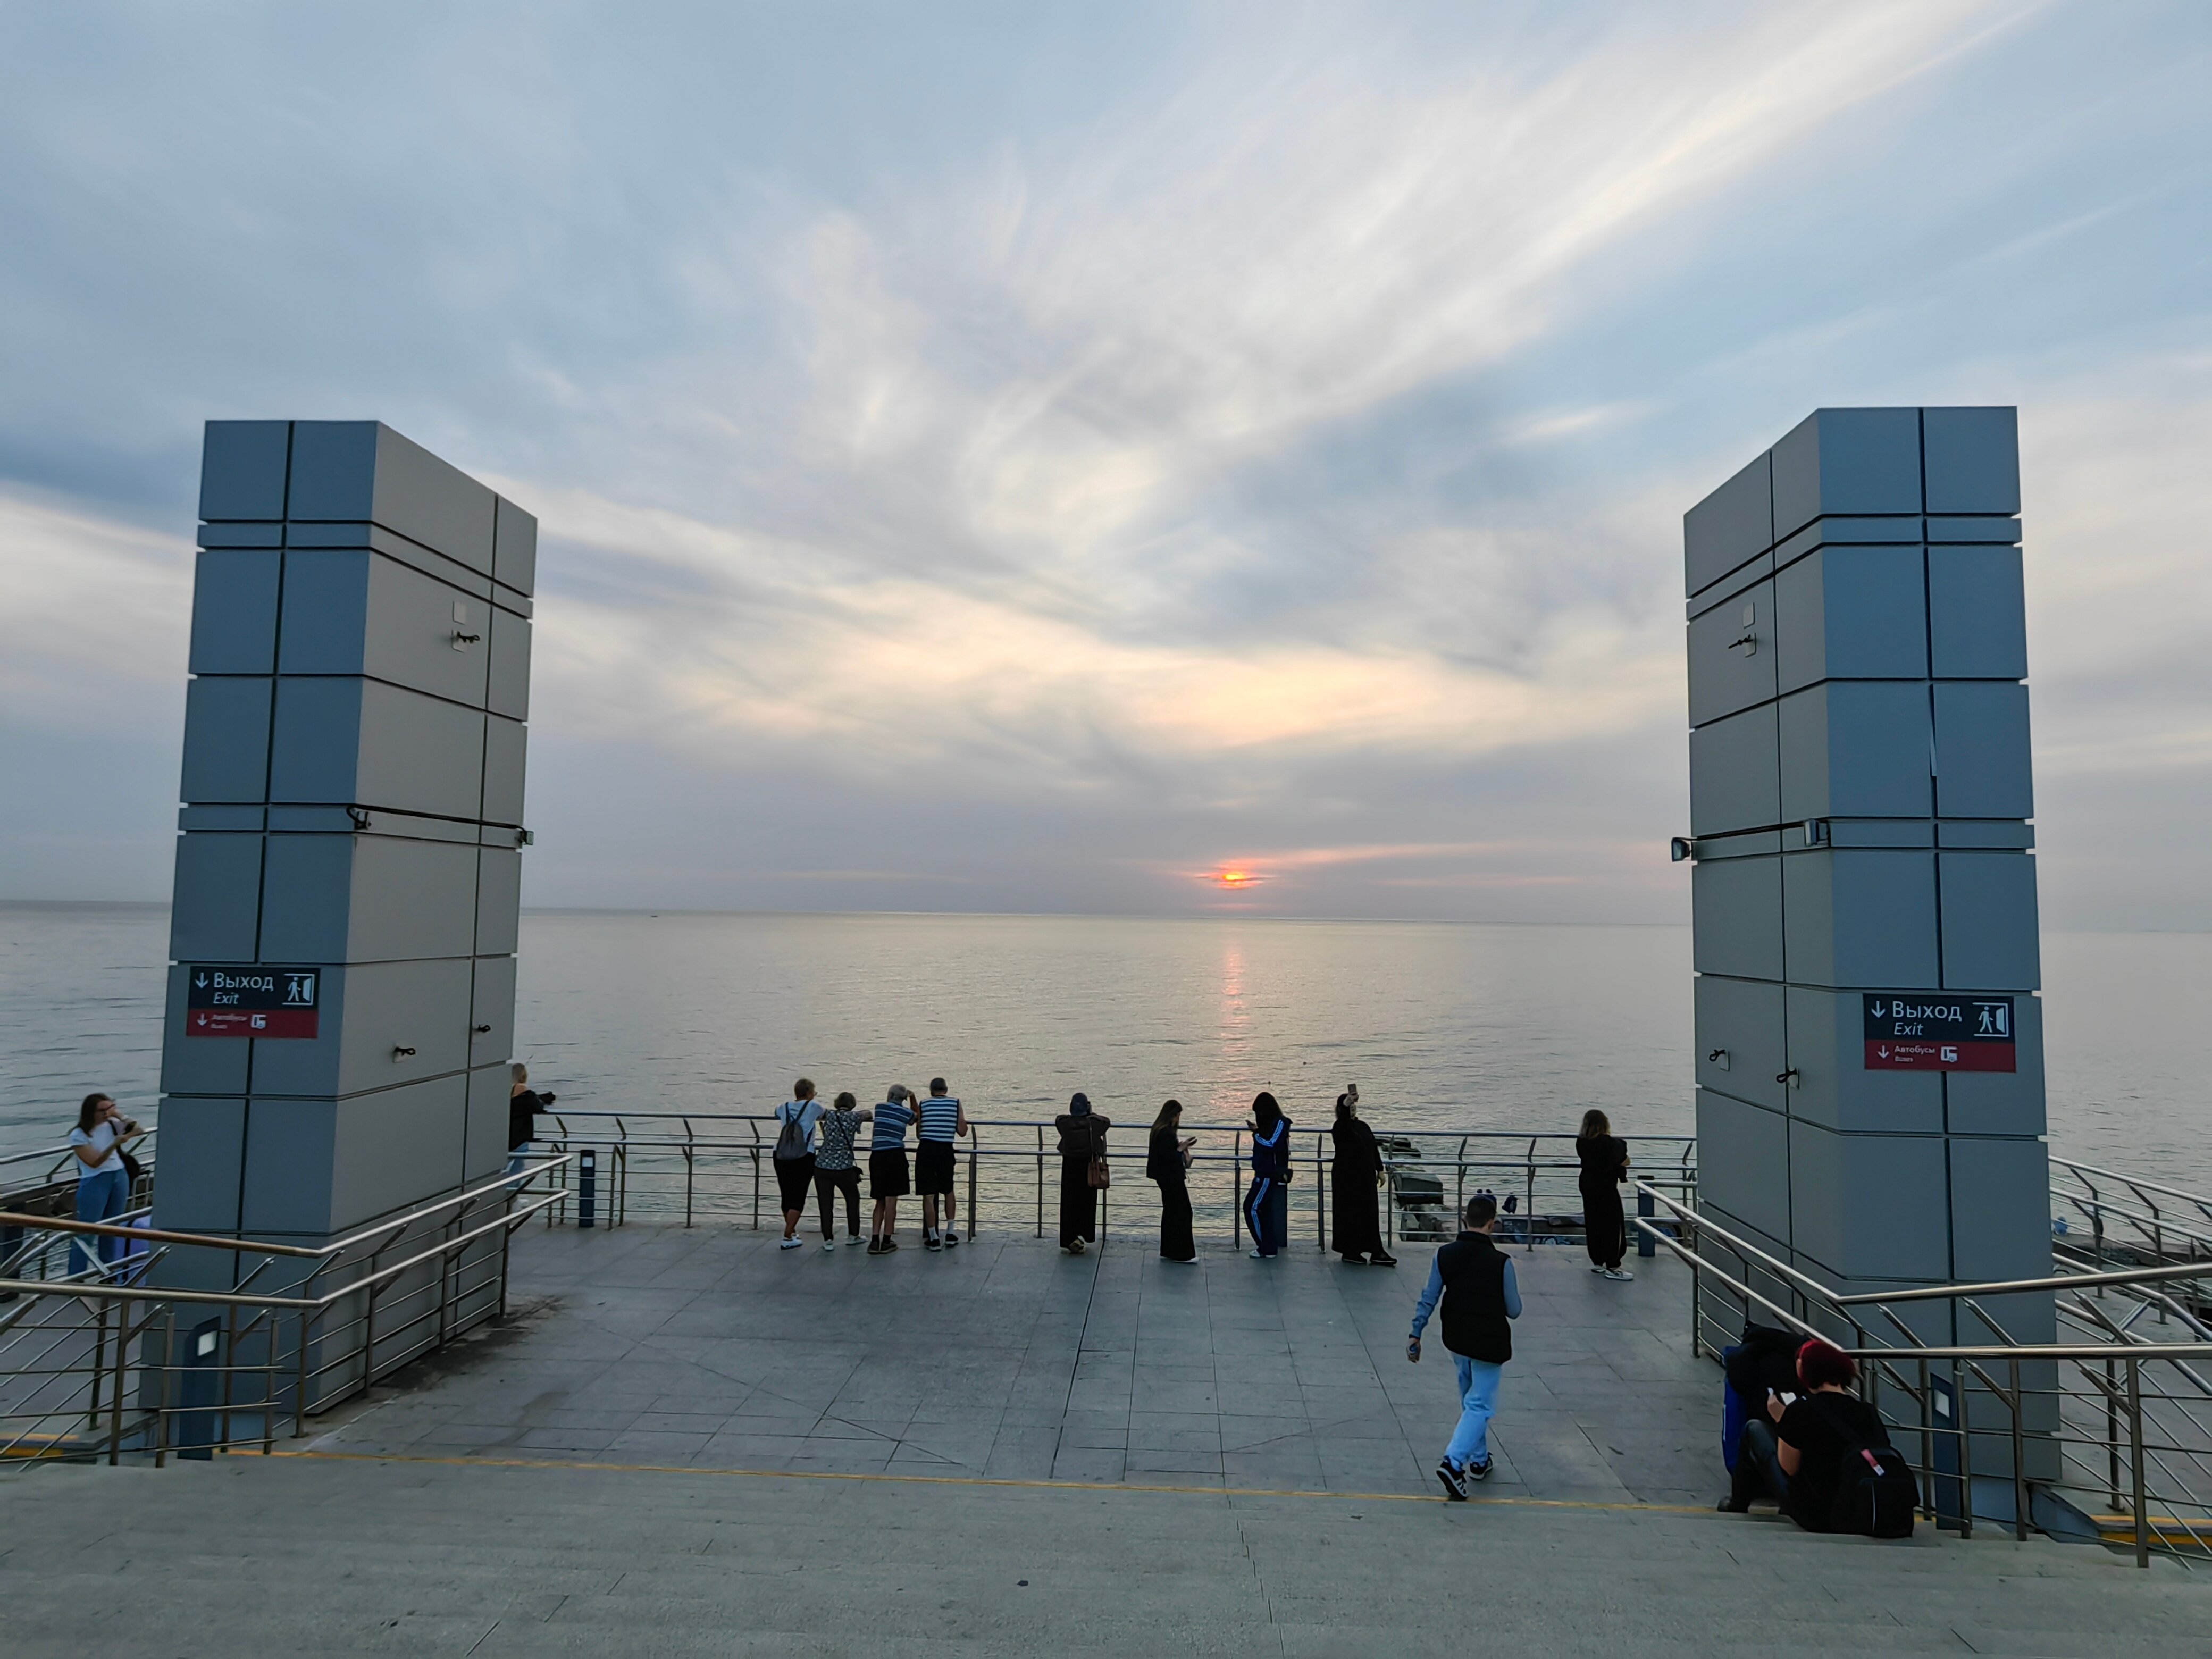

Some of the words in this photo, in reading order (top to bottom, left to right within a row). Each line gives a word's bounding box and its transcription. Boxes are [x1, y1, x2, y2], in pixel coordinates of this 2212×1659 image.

[214, 973, 273, 991] Выход
[213, 993, 239, 1004] Exit
[1892, 1001, 1962, 1021] Выход
[1894, 1023, 1923, 1035] Exit
[1895, 1046, 1935, 1054] Автобусы
